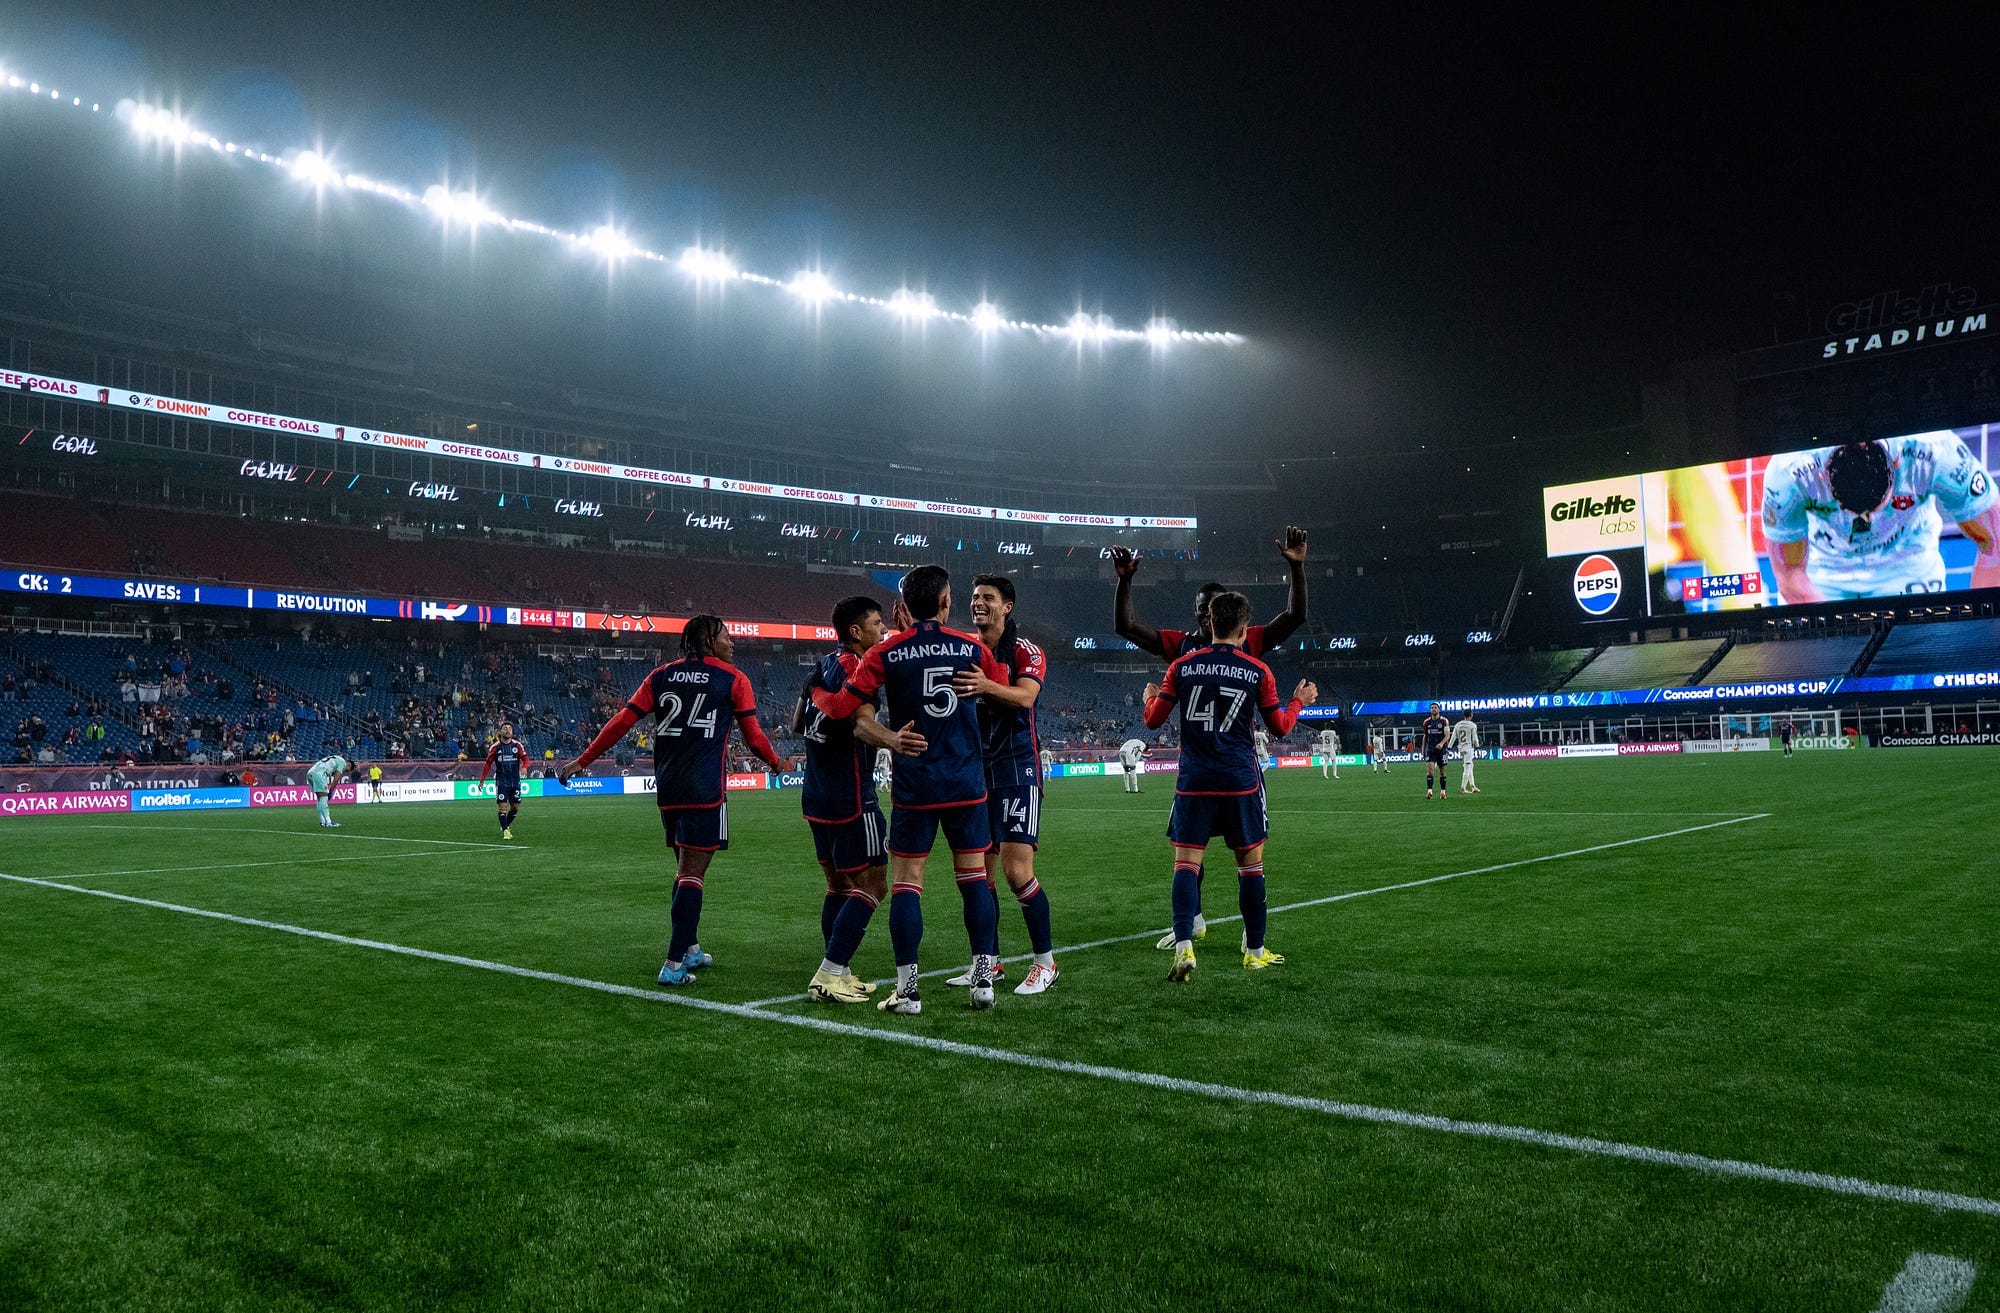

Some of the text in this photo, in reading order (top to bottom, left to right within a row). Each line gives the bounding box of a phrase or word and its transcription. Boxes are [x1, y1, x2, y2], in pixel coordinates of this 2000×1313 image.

[1823, 313, 1987, 358] STADIUM
[27, 377, 78, 395] GOALS
[156, 398, 320, 434] DUNKIN' COFFEE GOALS
[52, 434, 98, 455] GOAL
[383, 434, 519, 463] DUNKIN' COFFEE GOALS
[573, 461, 692, 485] DUNKIN' COFFEE GOALS
[738, 482, 844, 502] DUNKIN' COFFEE GOALS
[886, 498, 982, 516] DUNKIN' COFFEE GOALS
[1550, 494, 1636, 522] Gillette
[1020, 511, 1115, 525] DUNKIN' COFFEE GOALS
[1156, 517, 1188, 527] DUNKIN'
[1600, 516, 1636, 536] Labs
[18, 573, 200, 602] CK: 2 SAVES: 1
[1577, 577, 1618, 592] PEPSI
[1702, 575, 1740, 589] 54:46
[1747, 582, 1757, 592] 0
[1688, 588, 1696, 598] 4
[277, 593, 367, 614] REVOLUTION
[510, 611, 518, 622] 4
[523, 611, 553, 624] 54:46
[561, 618, 567, 626] 2
[887, 643, 974, 663] CHANCALAY
[668, 671, 710, 684] JONES
[1181, 663, 1259, 684] BAJRAKTAREVIC
[1933, 672, 2000, 687] @THECH
[923, 666, 958, 718] 5
[1716, 683, 1795, 698] CHAMPIONS
[1798, 681, 1827, 693] CUP
[1185, 685, 1248, 733] 47
[1436, 697, 1533, 711] THECHAMPIONS
[656, 691, 718, 738] 24
[1619, 743, 1680, 754] QATAR AIRWAYS
[1694, 742, 1718, 751] Hilton
[1882, 735, 1937, 746] Concacaf
[1502, 748, 1558, 758] QATAR AIRWAYS
[2, 795, 128, 813] QATAR AIRWAYS
[141, 793, 191, 806] molten
[253, 788, 354, 805] QATAR AIAYS
[1002, 797, 1027, 823] 14
